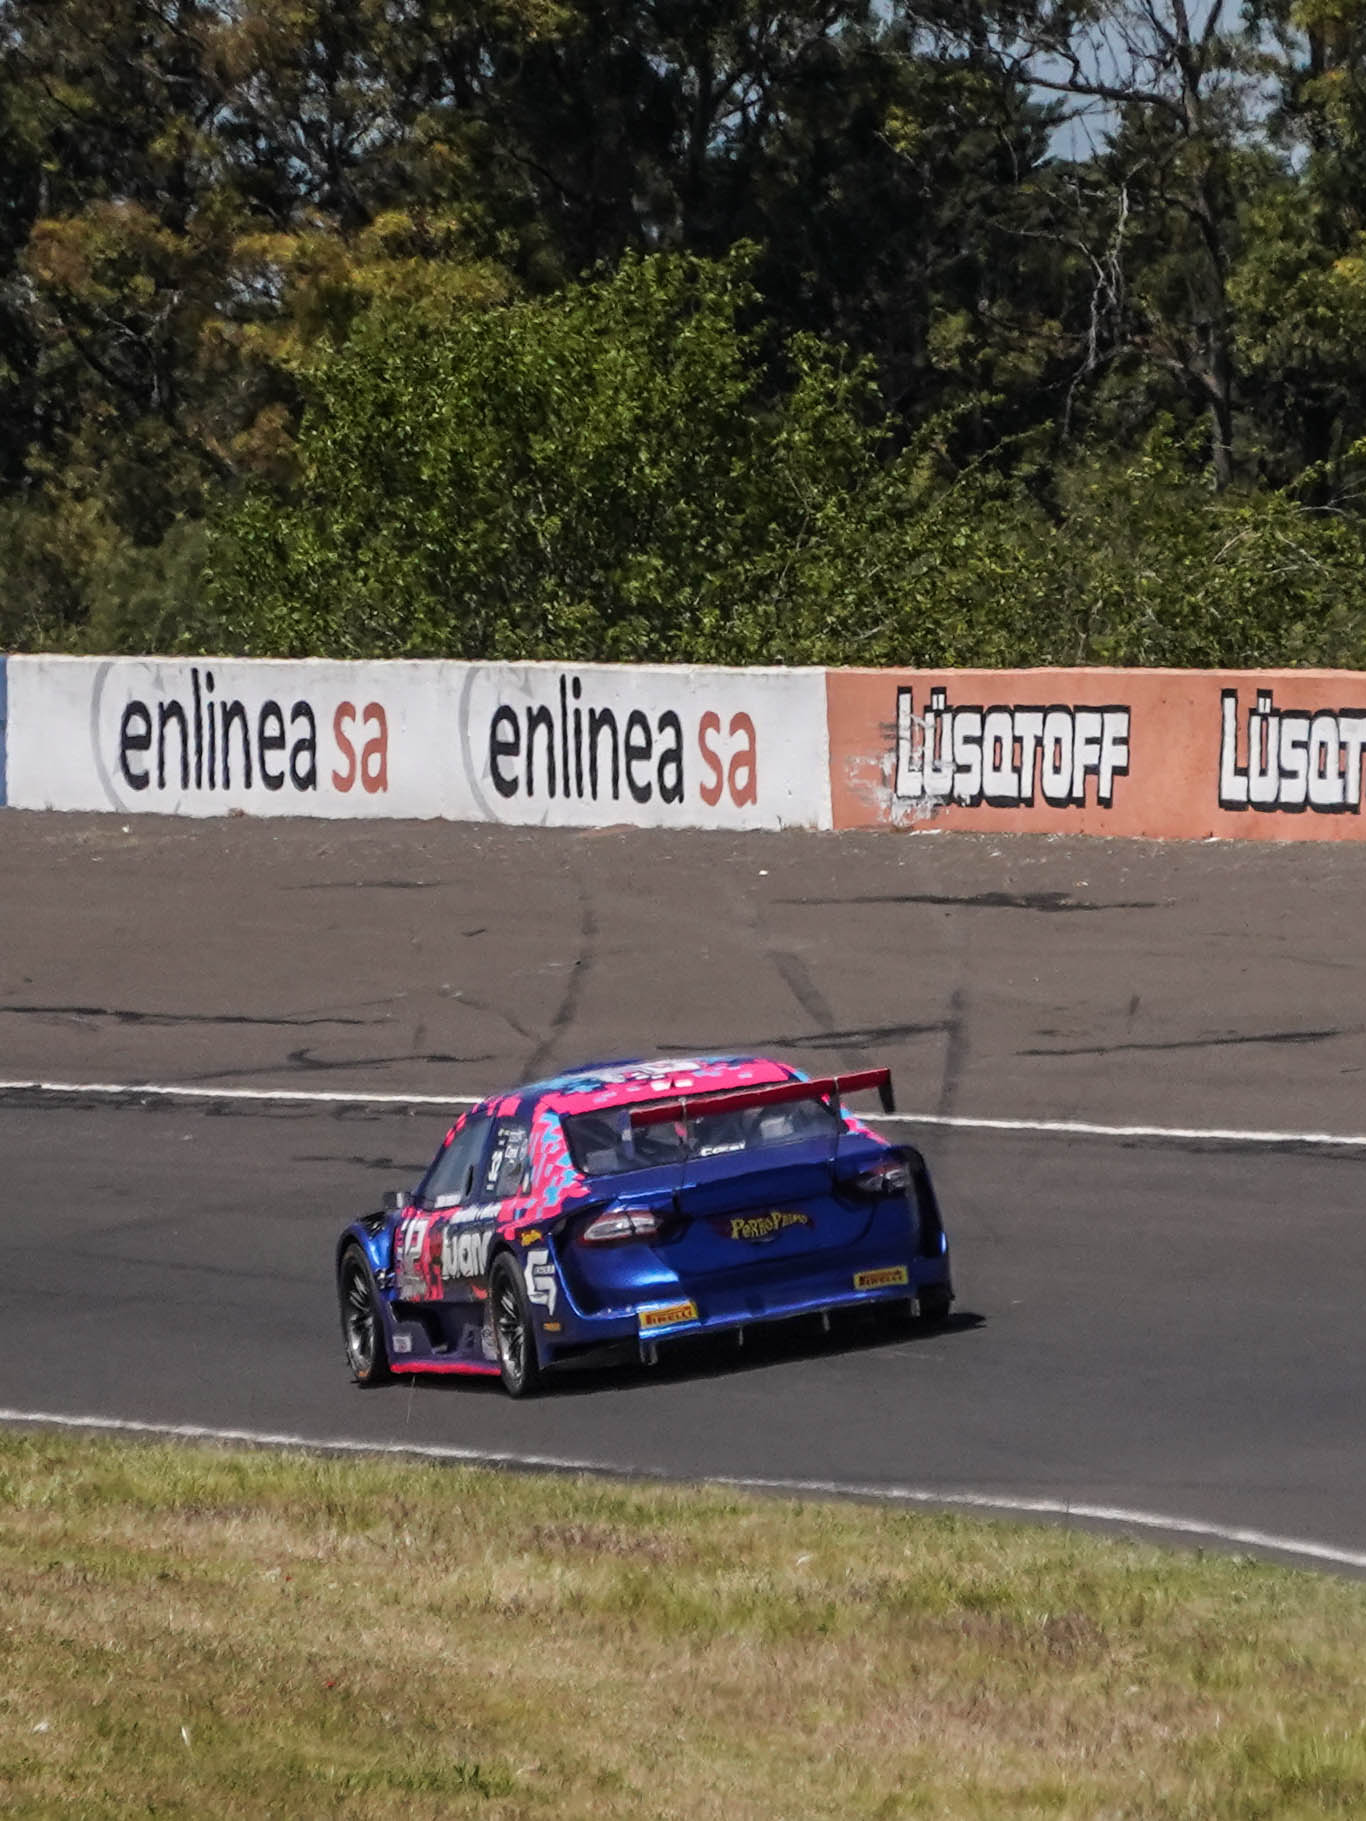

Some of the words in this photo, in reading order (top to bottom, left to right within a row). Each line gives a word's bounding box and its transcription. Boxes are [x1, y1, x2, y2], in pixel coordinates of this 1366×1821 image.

[119, 667, 317, 791] enlinea
[332, 700, 389, 794] sa
[489, 674, 684, 805] enlinea
[698, 710, 758, 808] sa
[645, 1305, 694, 1326] PIRELLI
[858, 1270, 905, 1289] PIRELLI
